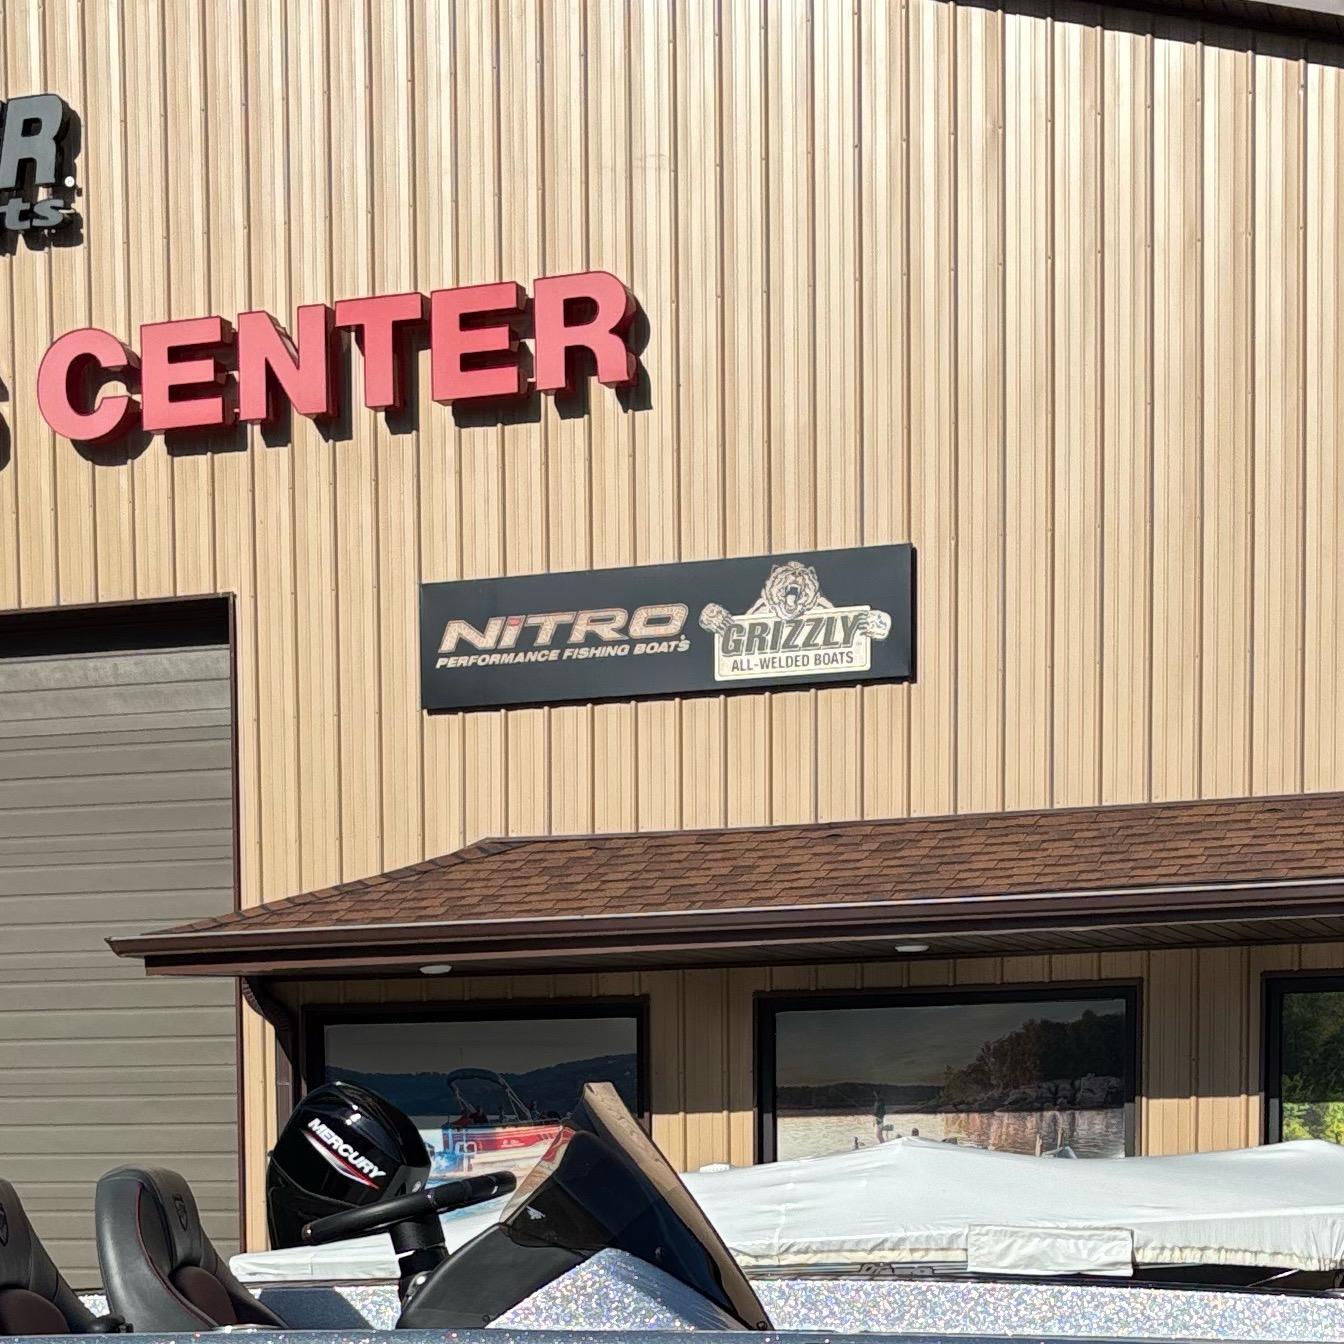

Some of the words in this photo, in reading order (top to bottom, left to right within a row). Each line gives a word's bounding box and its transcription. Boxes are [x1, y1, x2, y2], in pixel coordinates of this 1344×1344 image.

[37, 270, 632, 441] CENTER
[435, 650, 560, 669] PERFORMANCE
[562, 644, 629, 660] FISHING
[633, 639, 691, 656] BOATS
[721, 615, 859, 657] GRIZZLY
[731, 654, 810, 672] ALL-WELDED
[814, 651, 854, 666] BOATS
[308, 1118, 386, 1179] MERCURY
